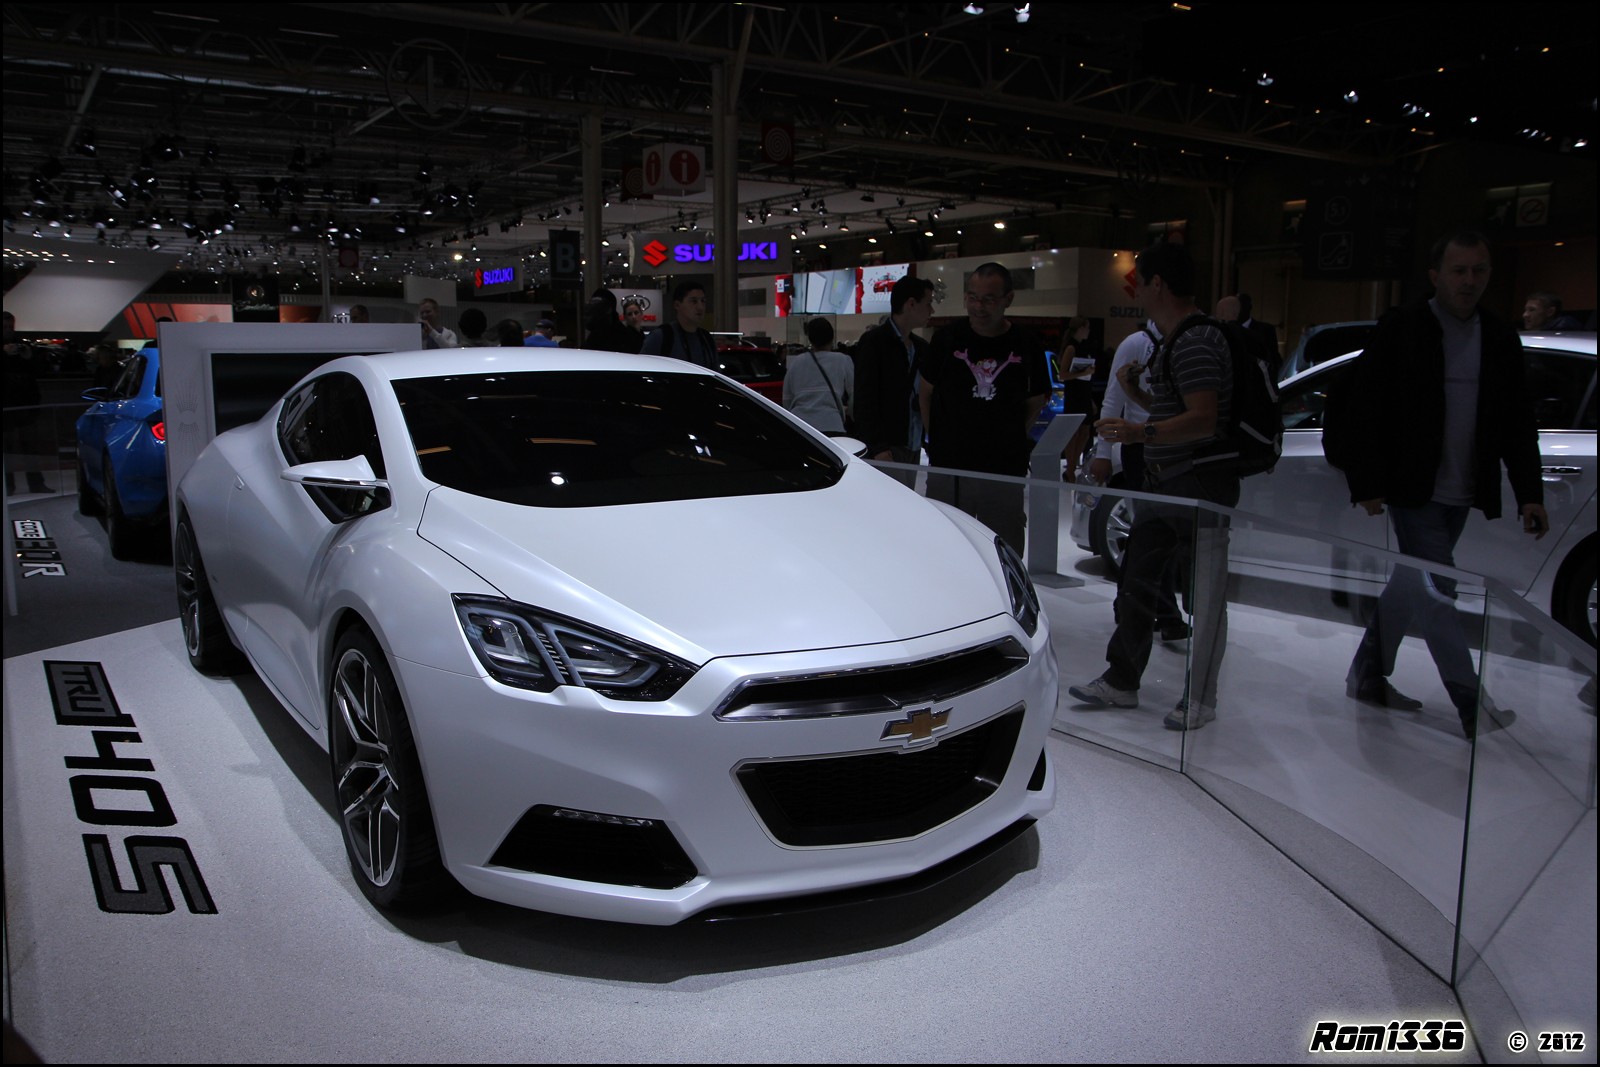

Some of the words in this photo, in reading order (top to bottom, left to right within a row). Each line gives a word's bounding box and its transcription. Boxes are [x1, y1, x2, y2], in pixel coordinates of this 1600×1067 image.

[556, 242, 576, 273] B
[674, 241, 778, 262] SUUKI
[483, 267, 514, 285] SUZUKI
[1110, 306, 1145, 318] SUZU
[61, 666, 105, 713] TRU
